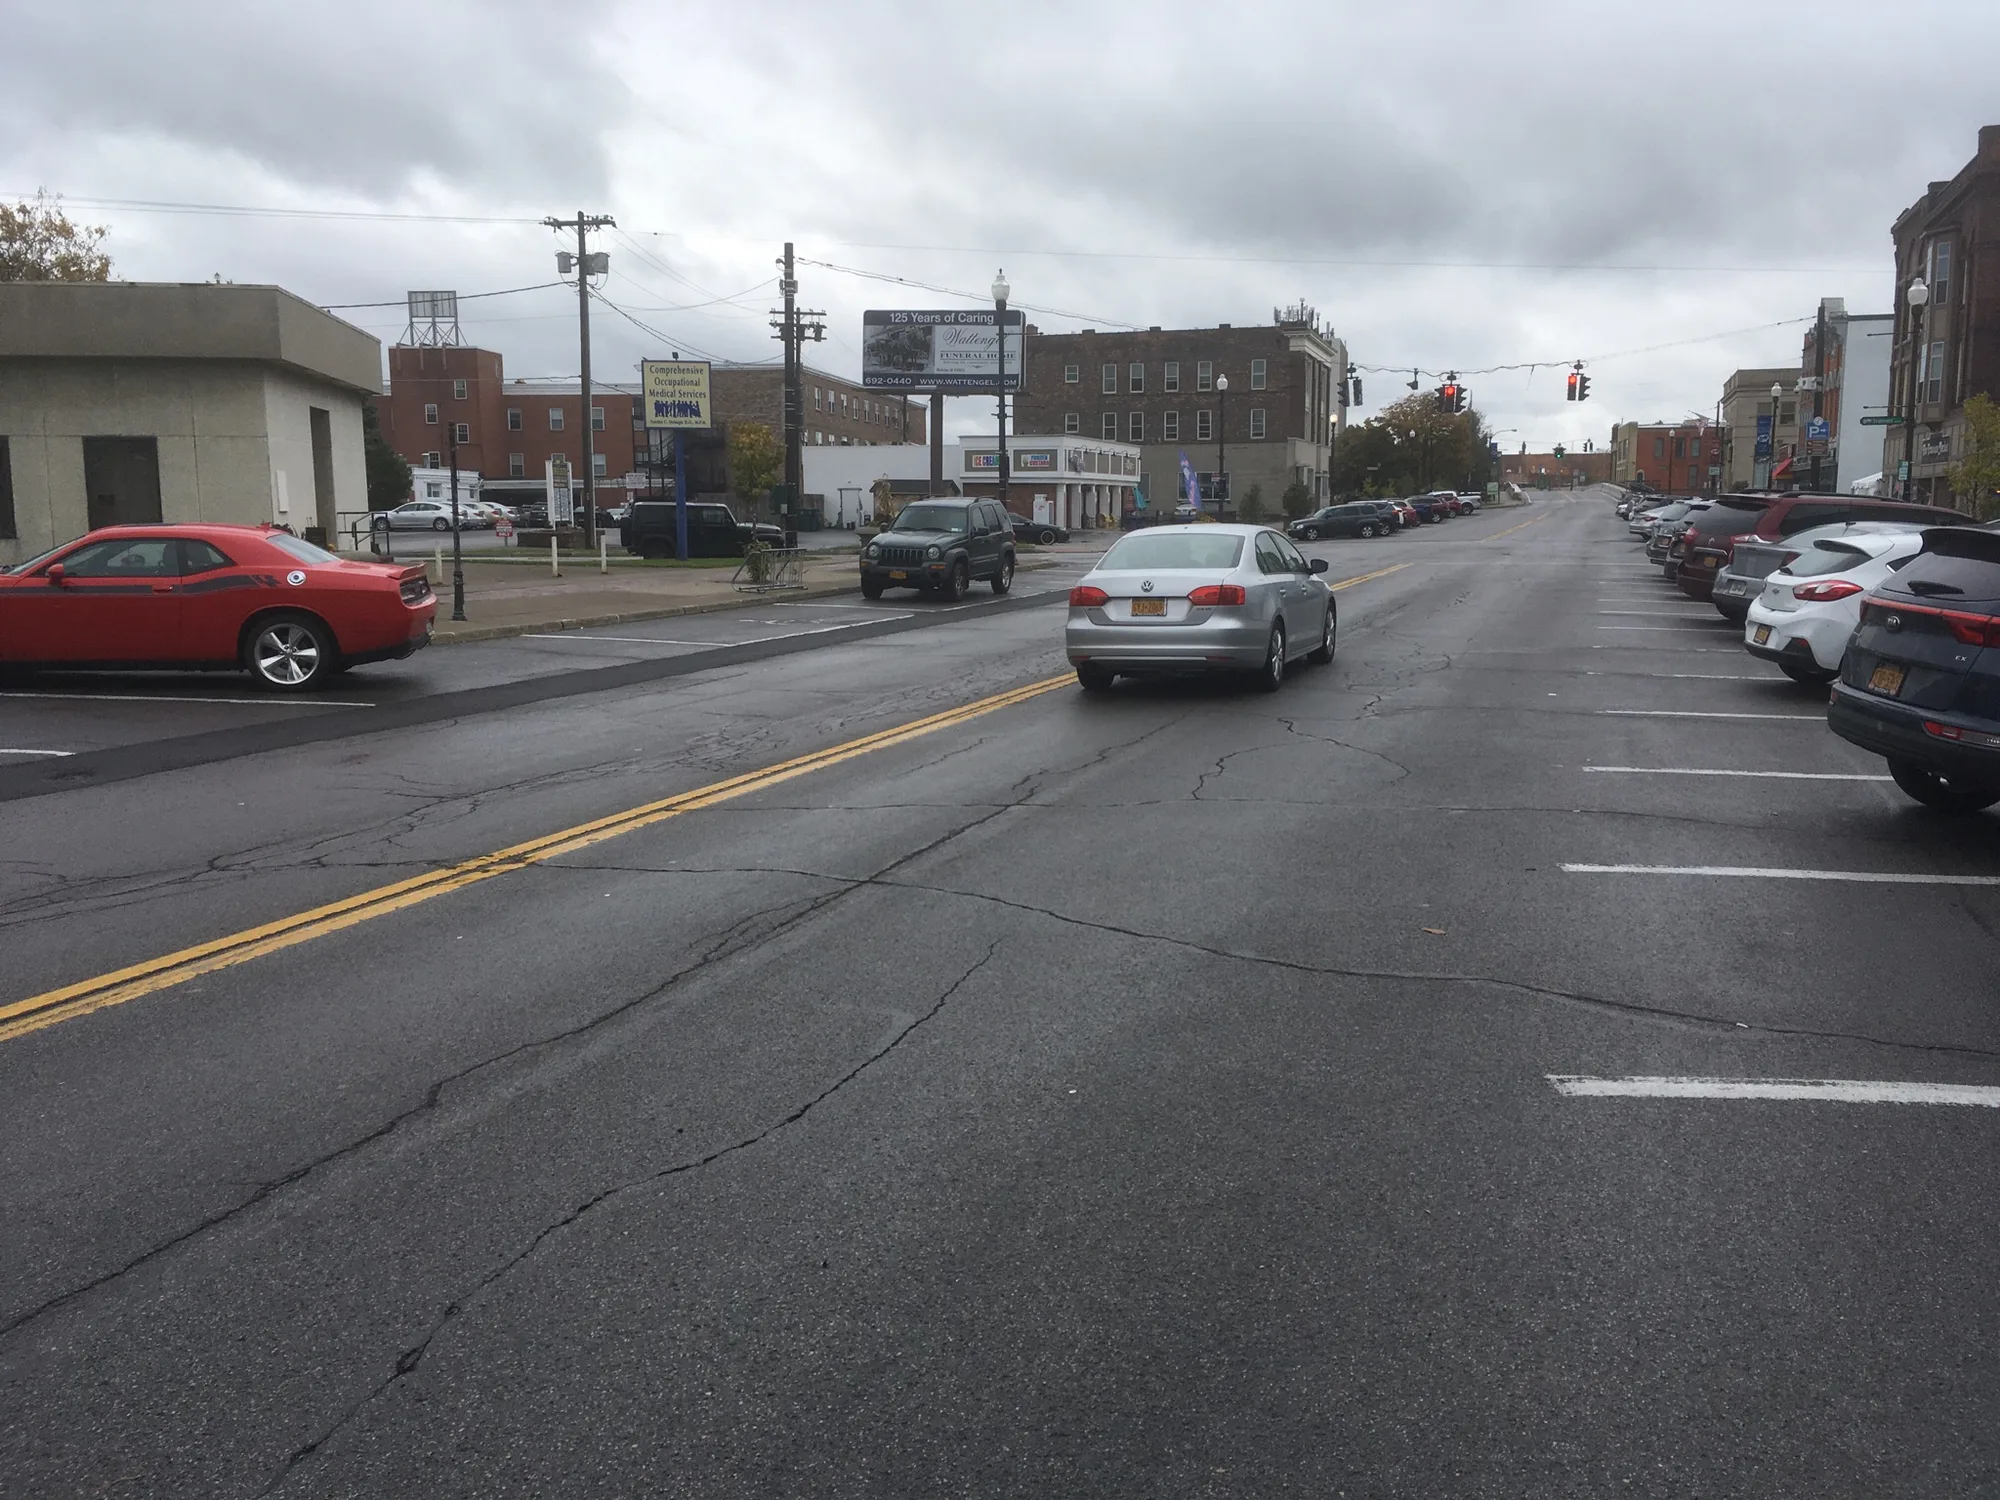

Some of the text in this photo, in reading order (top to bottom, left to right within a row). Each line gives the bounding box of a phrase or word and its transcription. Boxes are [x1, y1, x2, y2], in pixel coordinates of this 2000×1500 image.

[890, 312, 994, 325] 125 Years of Caring
[649, 365, 704, 376] Comprehensive
[654, 377, 701, 388] Occupational
[865, 377, 912, 385] 692-0440
[649, 389, 707, 399] Medical Services
[1809, 426, 1820, 438] P
